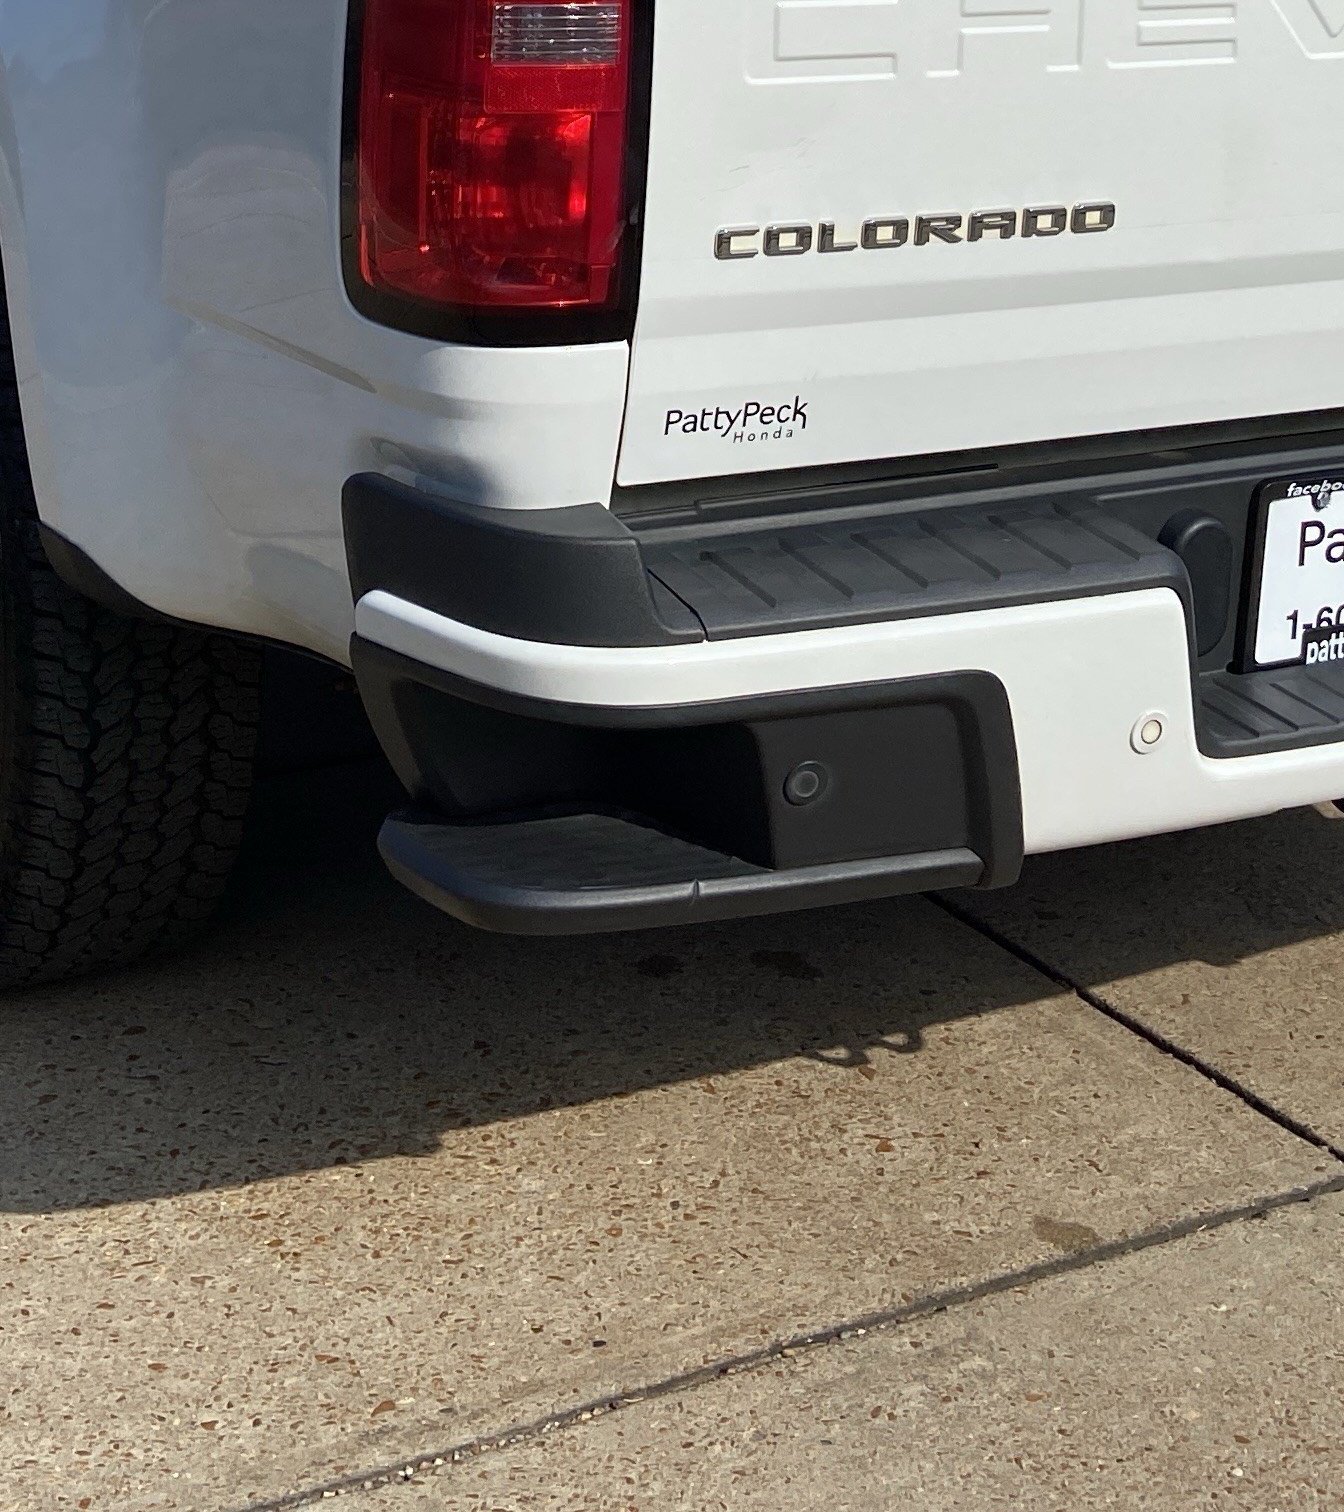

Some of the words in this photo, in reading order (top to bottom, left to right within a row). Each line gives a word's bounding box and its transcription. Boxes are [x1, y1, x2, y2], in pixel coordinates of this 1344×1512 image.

[713, 199, 1117, 260] COLORADO
[663, 395, 808, 437] PattyPeck
[733, 427, 794, 444] Honda
